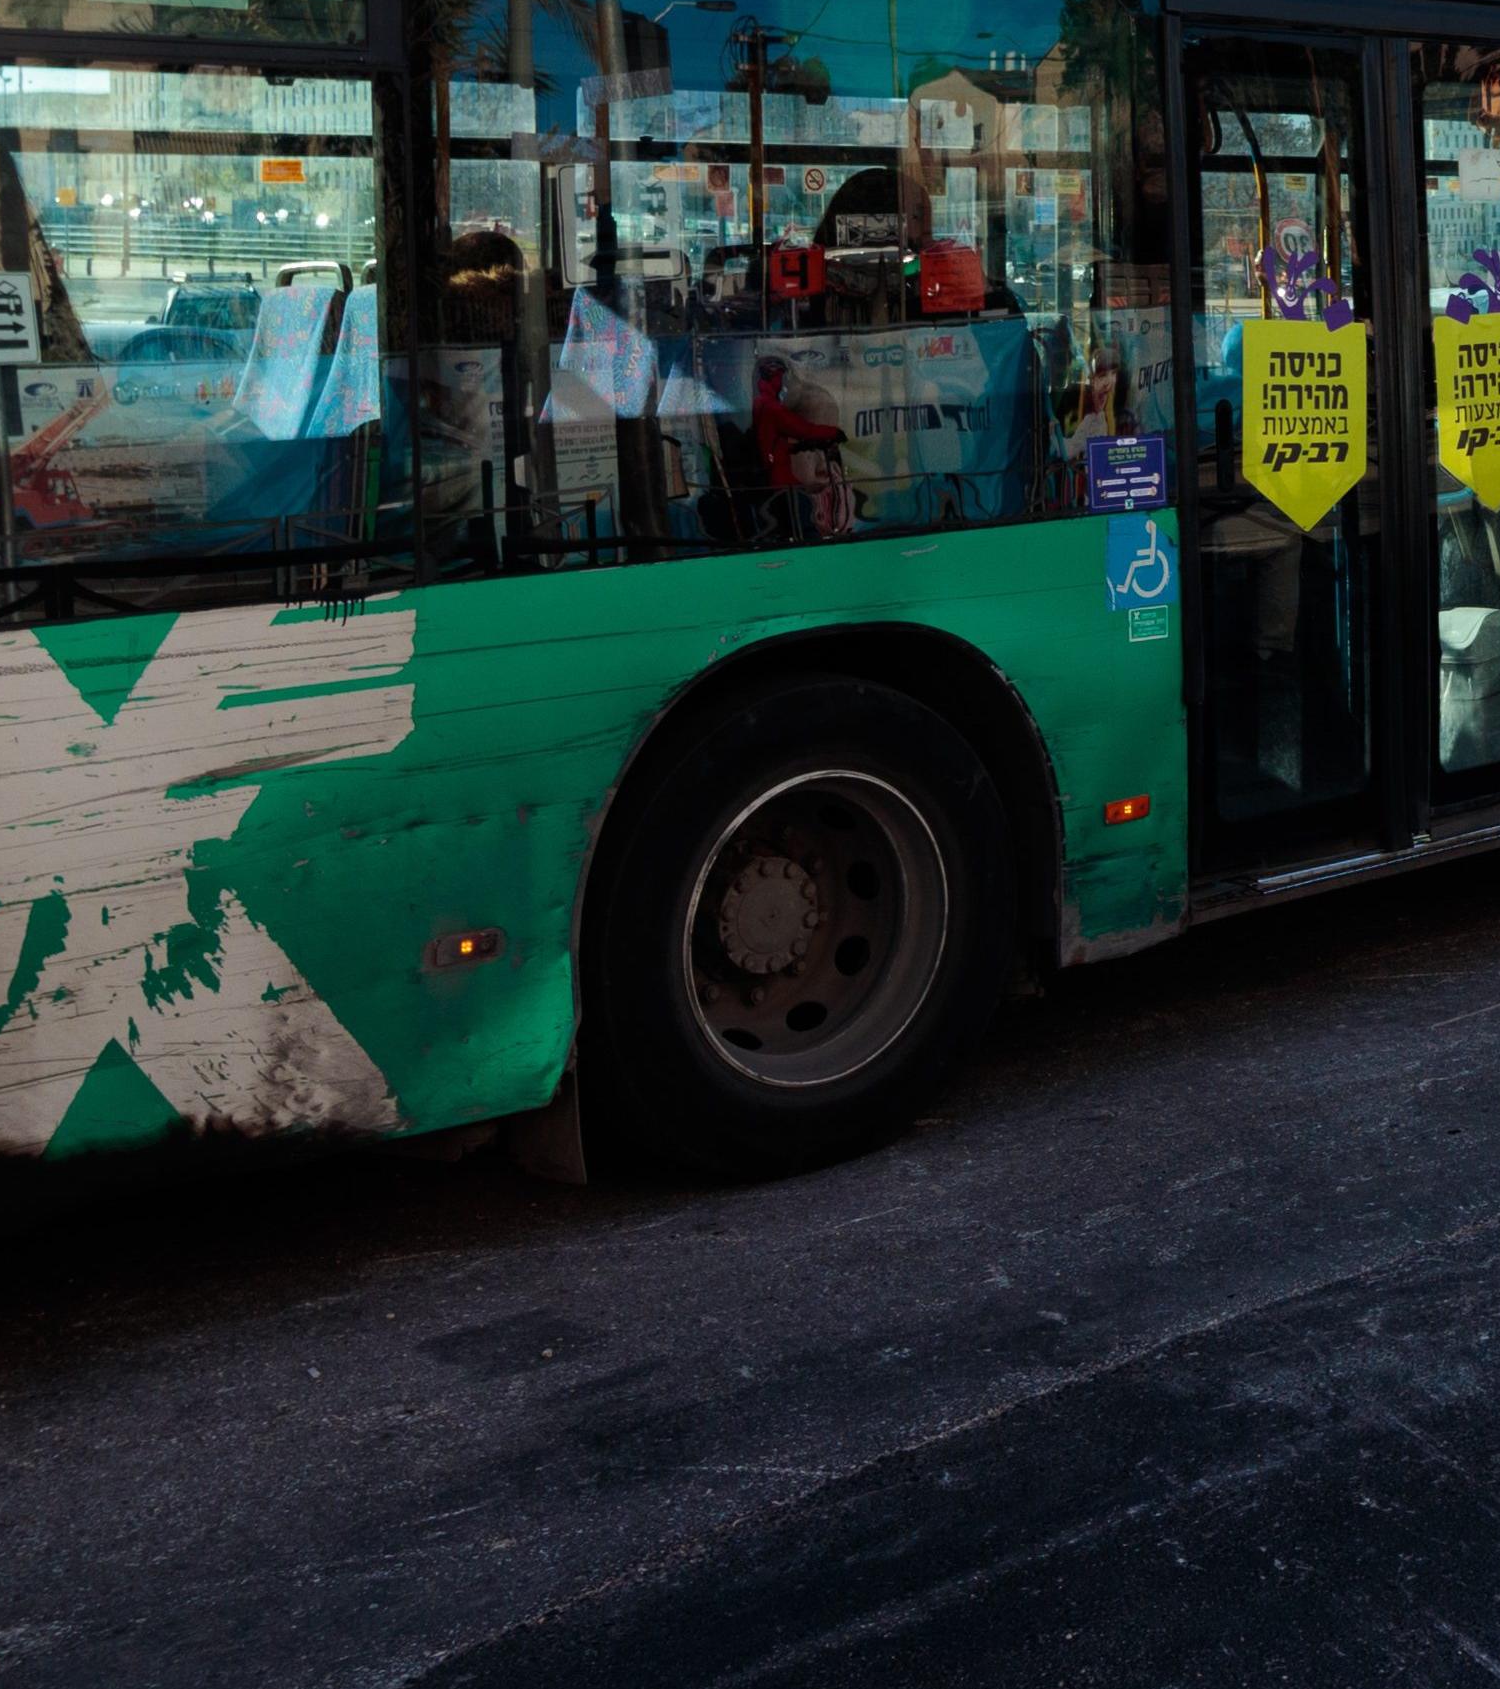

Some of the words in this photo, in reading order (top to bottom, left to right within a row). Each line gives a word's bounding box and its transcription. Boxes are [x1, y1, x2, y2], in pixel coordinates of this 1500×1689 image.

[1269, 351, 1342, 378] כניסה
[1262, 383, 1348, 409] מהירה!
[1262, 416, 1349, 435] באמצעות
